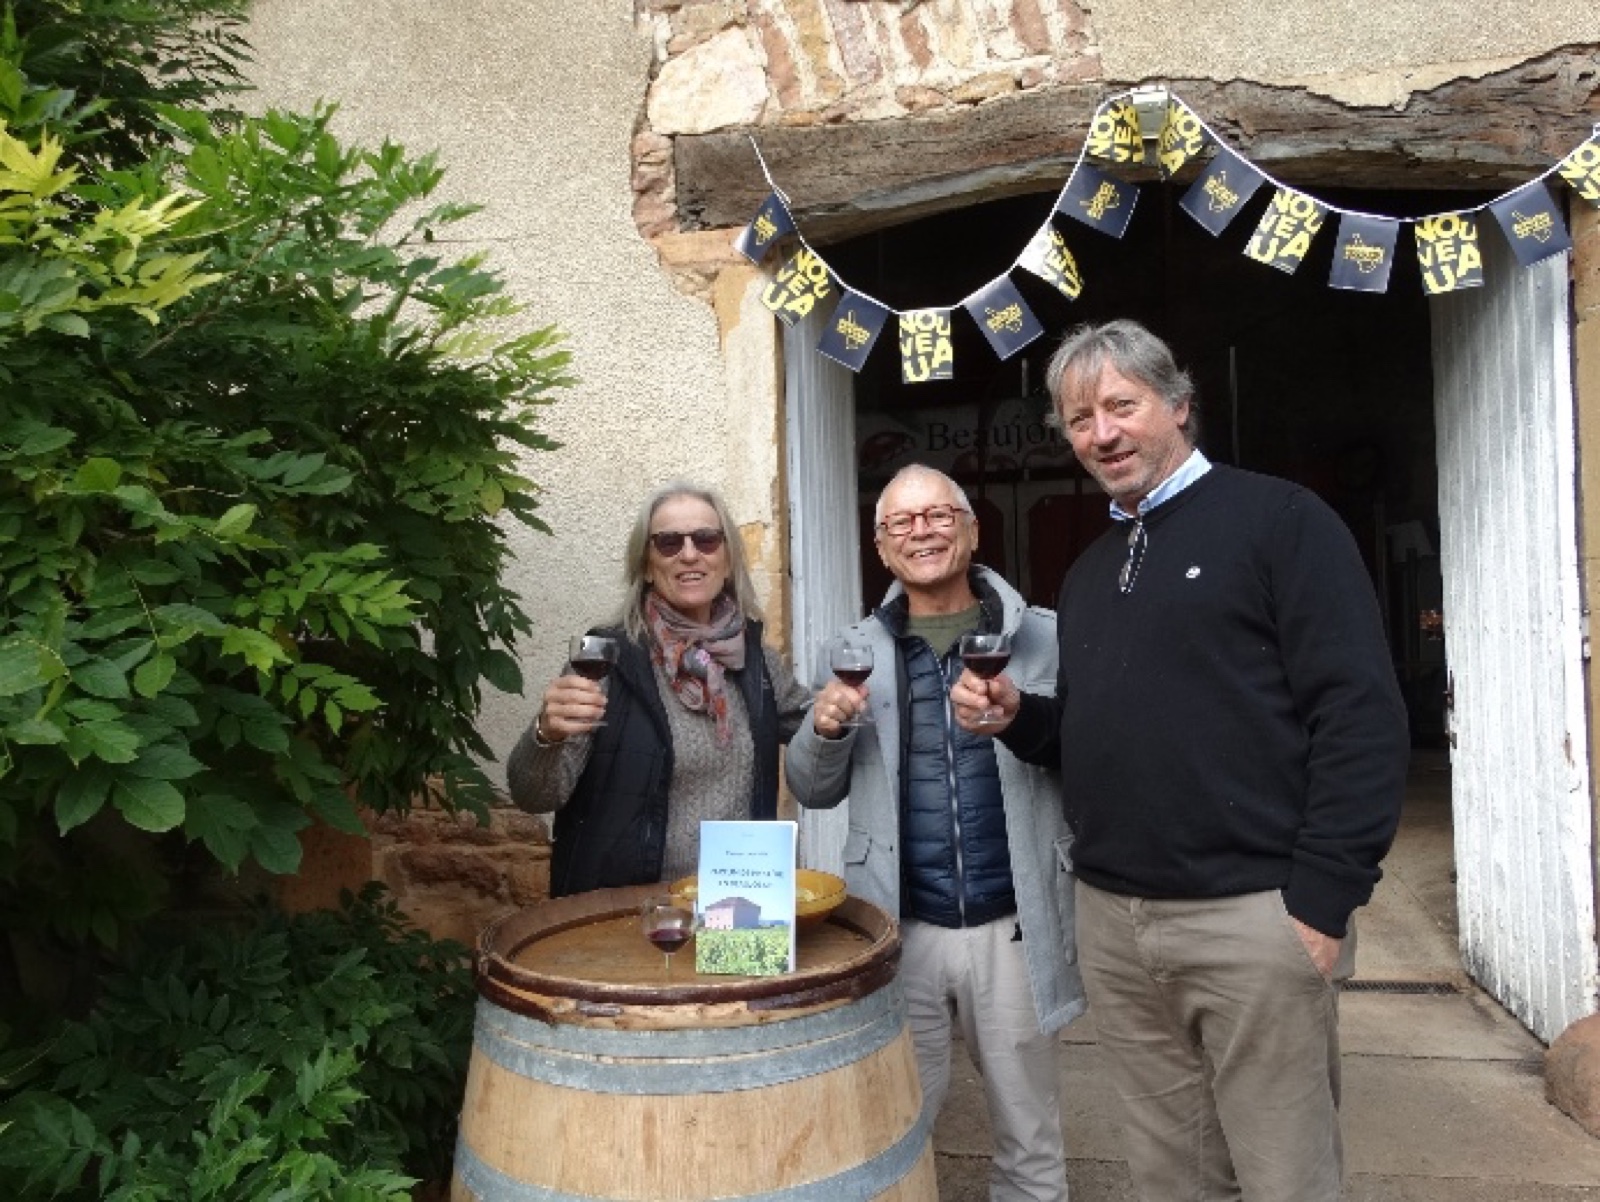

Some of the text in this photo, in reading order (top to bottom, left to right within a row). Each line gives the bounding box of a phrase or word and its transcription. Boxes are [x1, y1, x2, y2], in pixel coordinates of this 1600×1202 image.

[1557, 141, 1600, 188] NO
[1272, 188, 1323, 234] NOU
[1415, 214, 1477, 242] NOU
[899, 310, 952, 336] NOU
